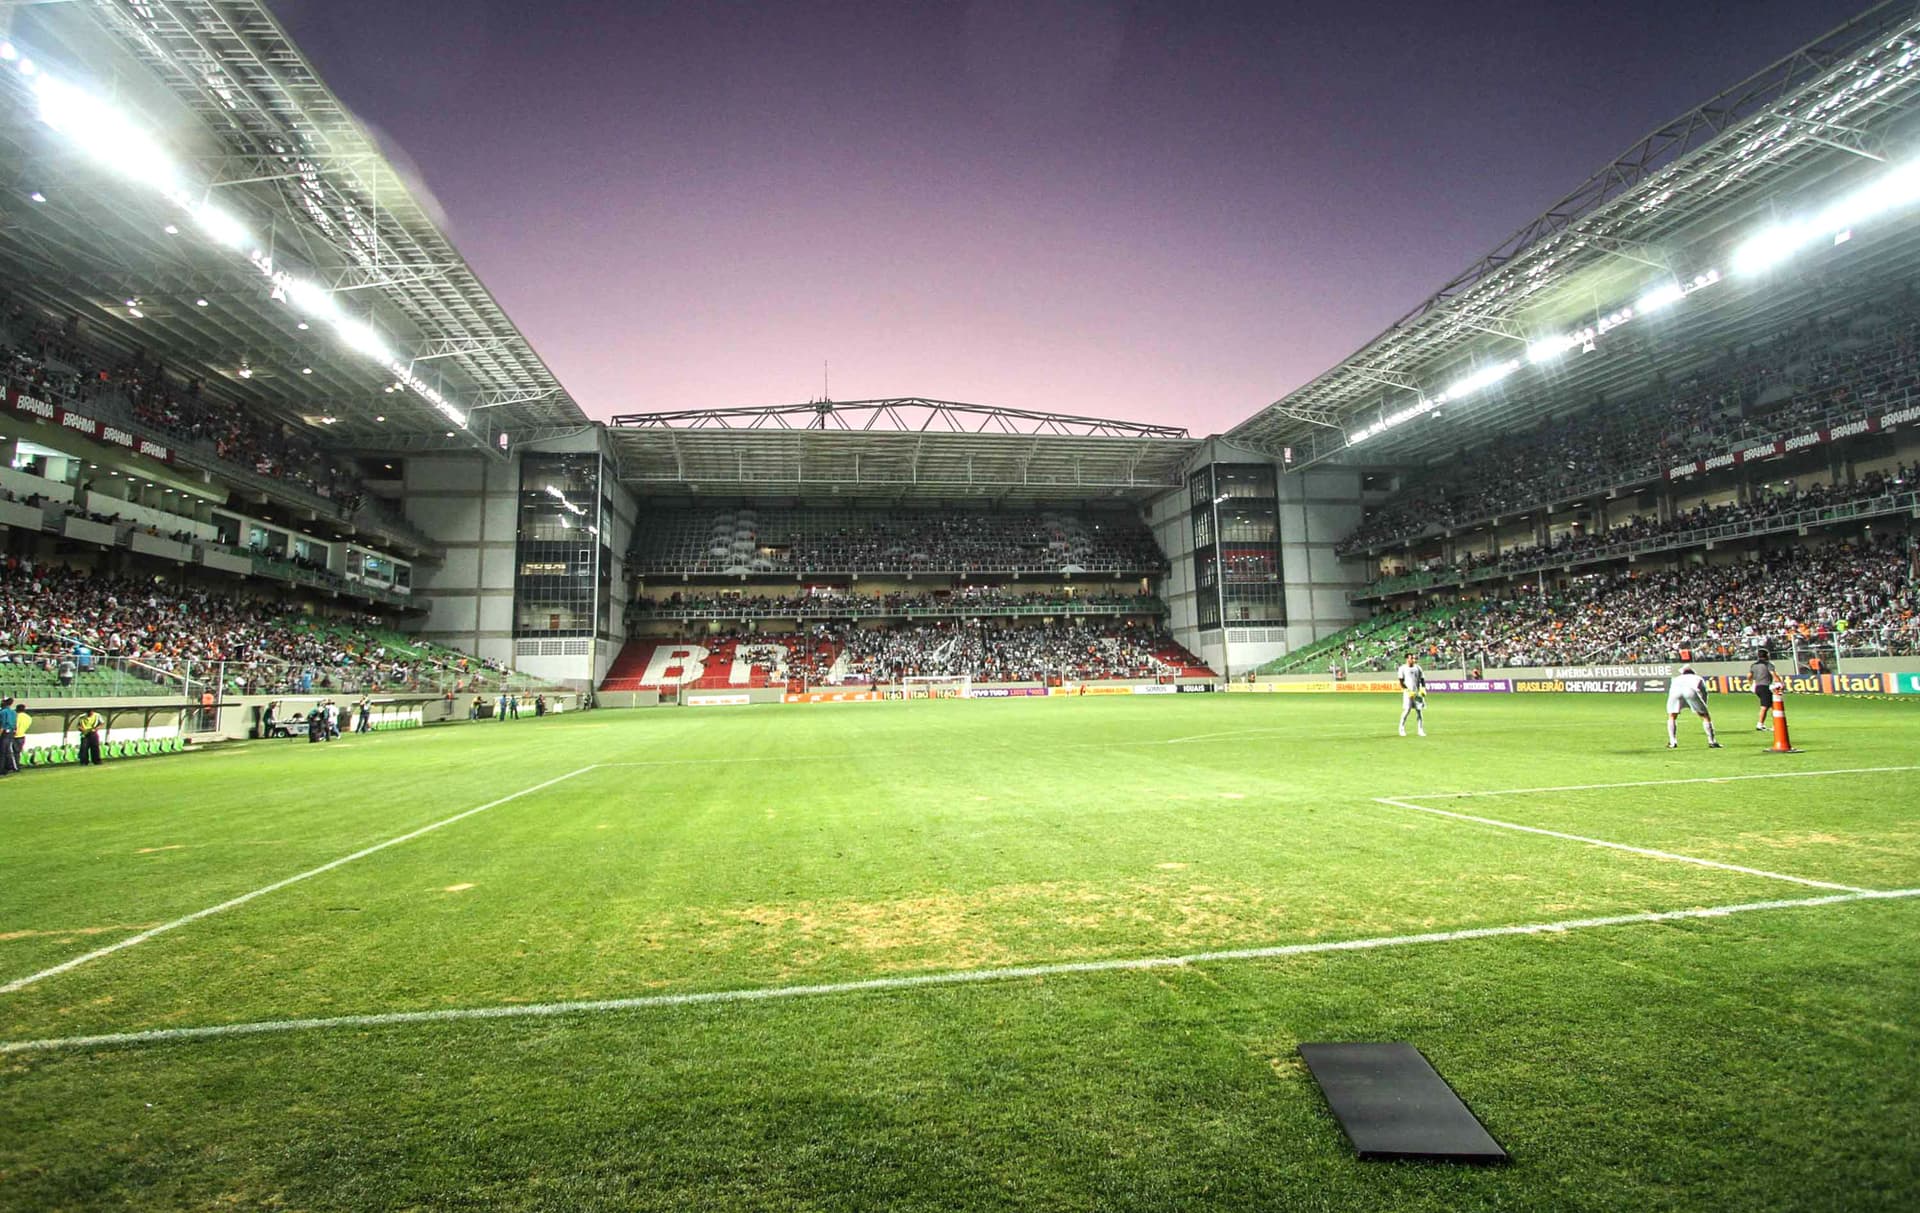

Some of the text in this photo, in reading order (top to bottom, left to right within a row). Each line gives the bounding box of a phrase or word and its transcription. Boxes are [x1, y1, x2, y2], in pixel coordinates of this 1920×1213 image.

[16, 395, 54, 418] BRAHMA
[62, 412, 96, 434] BRAHMA
[1880, 406, 1920, 428] BRAHMA
[103, 427, 133, 447] BRAHMA
[1830, 420, 1869, 440] BRAHMA
[140, 441, 167, 460] BRAHMA
[1784, 432, 1821, 452] BRAHMA
[1743, 443, 1776, 461] BRAHMA
[1669, 462, 1698, 479] BRAHMA
[1704, 453, 1735, 471] BRAHMA
[1595, 666, 1638, 677] FUTEBOL
[1639, 665, 1672, 676] CLUBE
[1516, 680, 1565, 692] BRASILEIRÃO
[1565, 681, 1615, 693] CHEVROLET
[1615, 681, 1638, 693] 2014
[1728, 676, 1755, 692] Ita
[1780, 675, 1819, 692] taú
[1833, 674, 1880, 692] Itaú
[911, 689, 929, 700] Itaú
